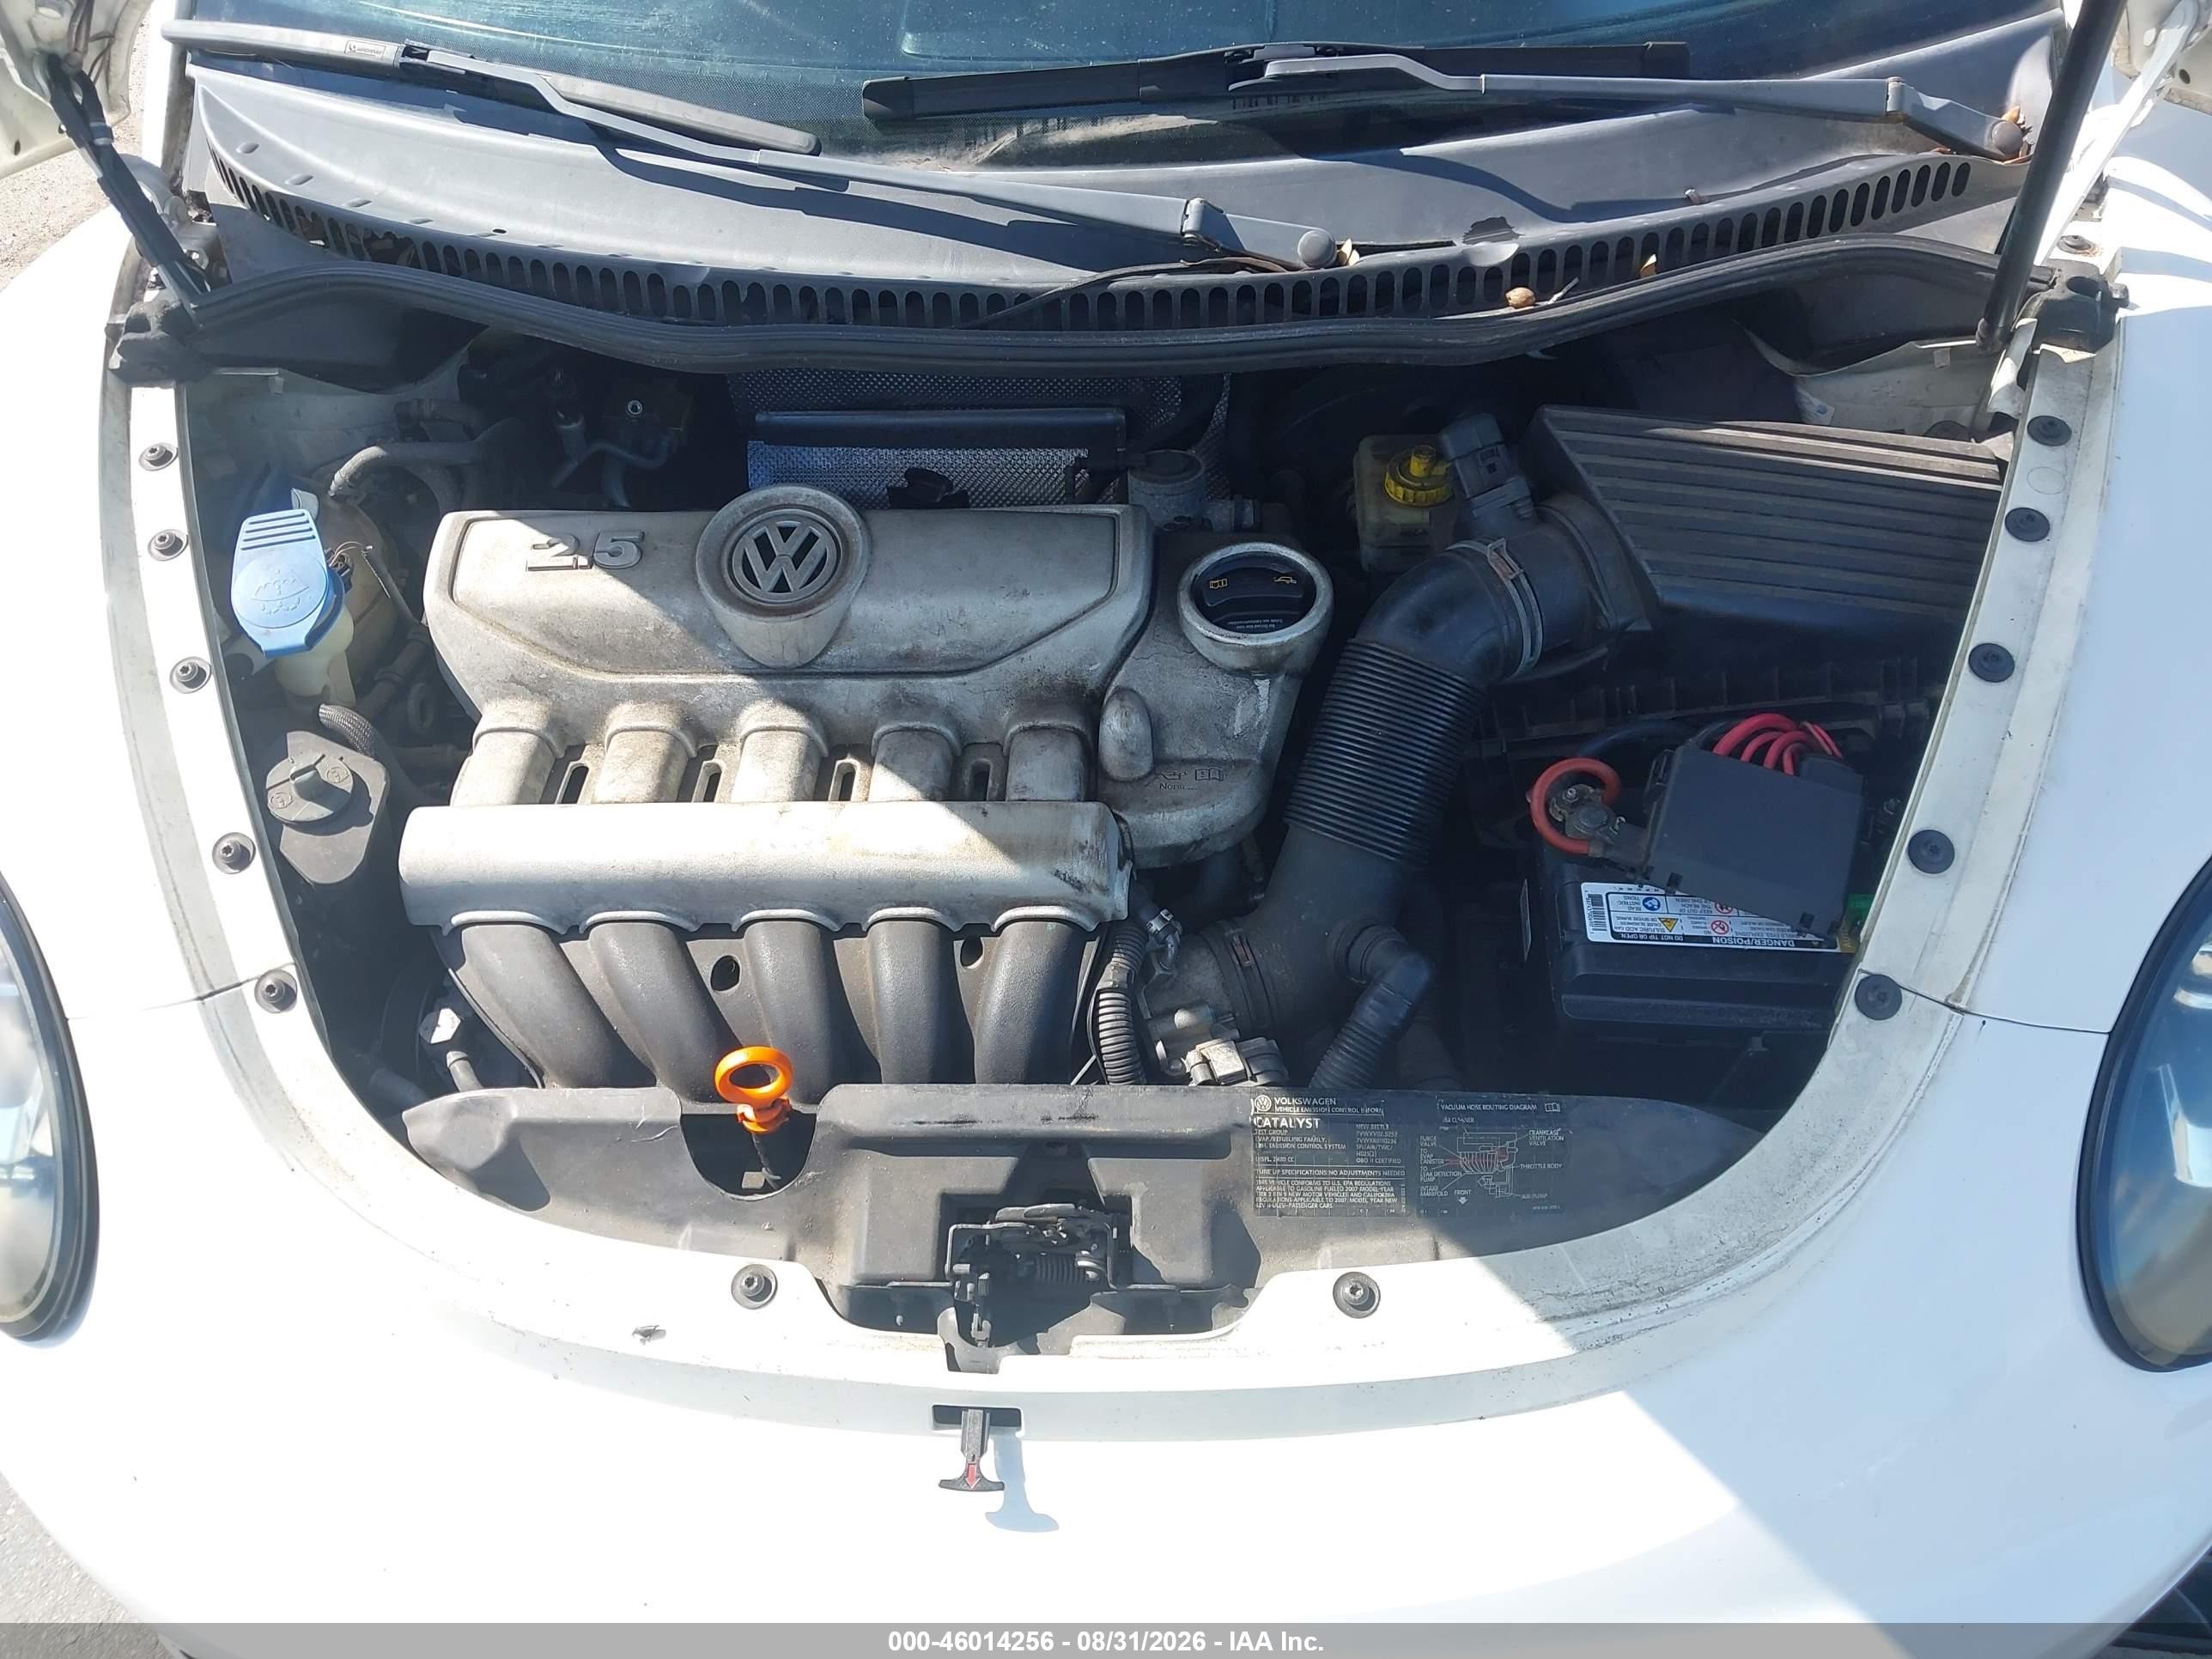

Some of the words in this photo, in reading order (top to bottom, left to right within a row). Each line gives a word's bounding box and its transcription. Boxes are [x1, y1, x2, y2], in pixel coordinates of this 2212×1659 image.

[1712, 936, 1796, 947] DANGER/POISON
[1274, 1097, 1336, 1105] VOLKSWAGEN
[1275, 1105, 1300, 1114] VEHICLE
[1254, 1116, 1322, 1129] CATALYST
